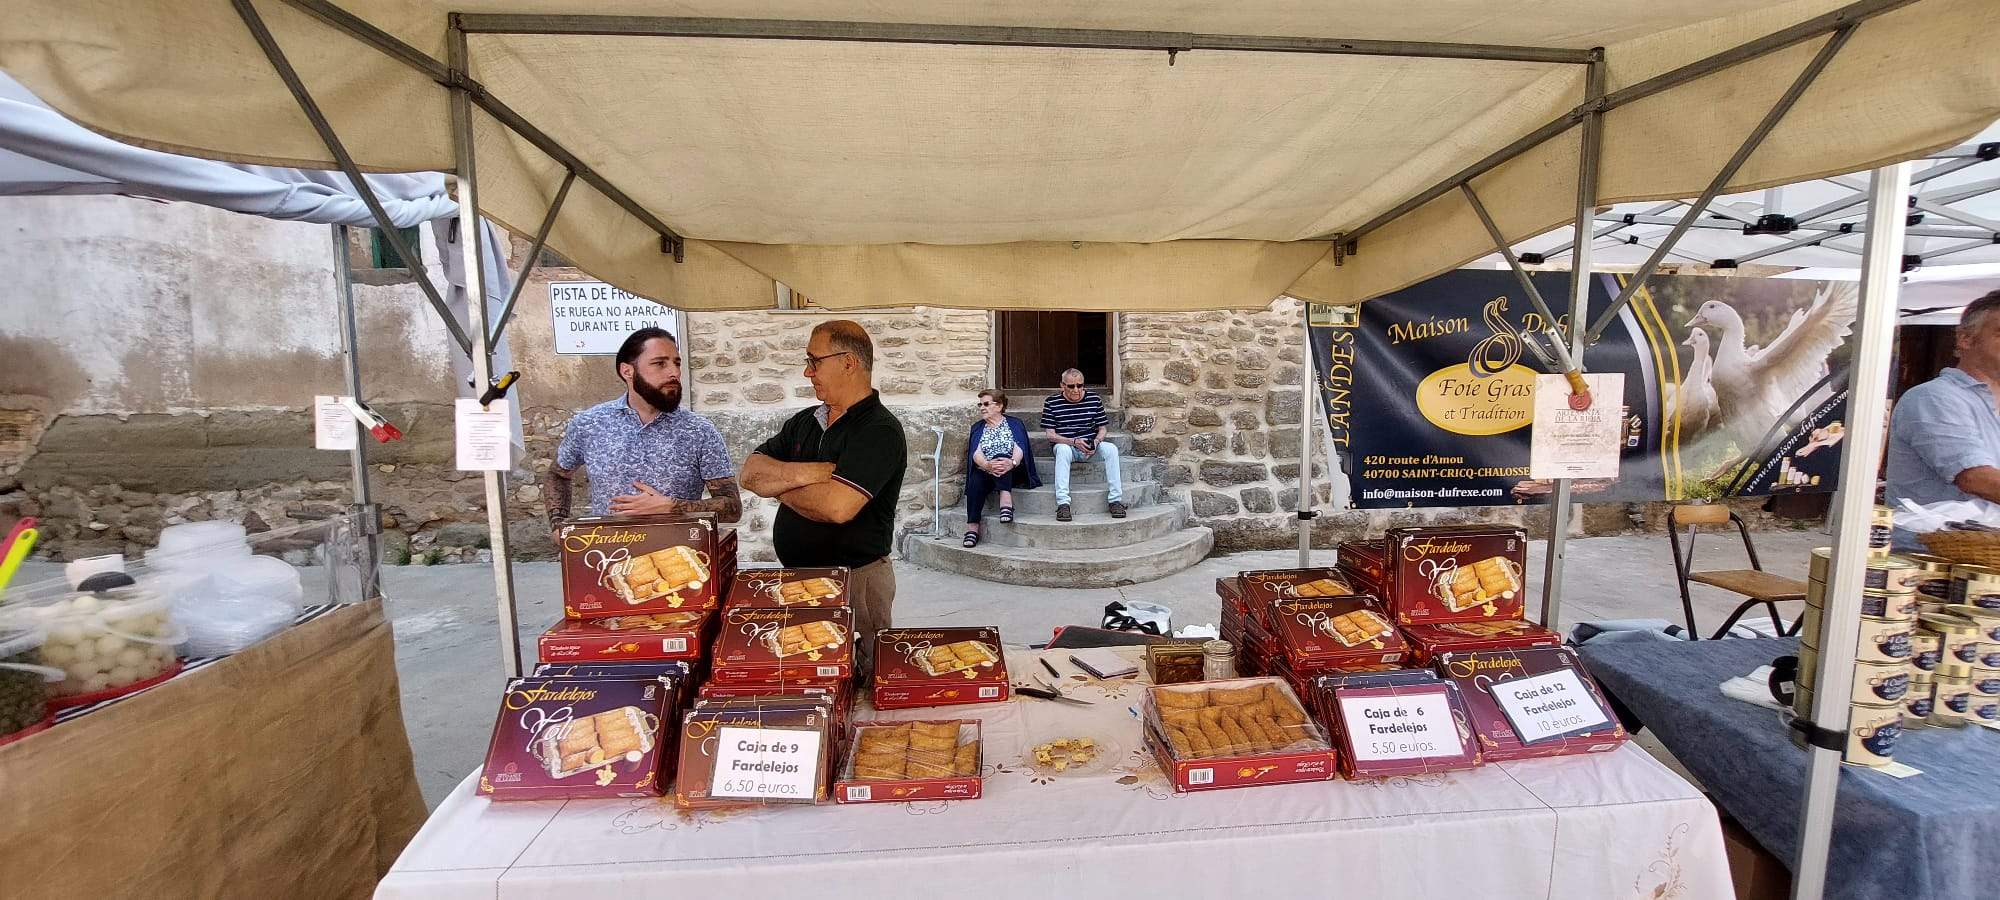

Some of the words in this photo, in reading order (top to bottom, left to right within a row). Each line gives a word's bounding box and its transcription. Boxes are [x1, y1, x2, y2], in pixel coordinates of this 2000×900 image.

[553, 287, 587, 301] PISTA
[591, 287, 607, 301] DE
[555, 306, 566, 318] SE
[569, 306, 602, 318] RUEGA
[606, 306, 621, 317] NO
[625, 305, 674, 317] APARCAR
[570, 321, 619, 331] DURANTE
[625, 320, 637, 331] EL
[1388, 315, 1470, 344] Maison
[1325, 330, 1355, 448] LANDES
[1439, 378, 1481, 397] Foie
[1488, 378, 1532, 402] Gras
[1444, 407, 1456, 420] et
[1459, 403, 1526, 420] Tradition
[1363, 455, 1386, 465] 420
[1388, 456, 1420, 465] route
[1422, 454, 1464, 465] d'Amou
[1363, 469, 1400, 479] 40700
[1401, 466, 1530, 479] SAINT-CRICQ-CHALOSSE
[1362, 487, 1503, 500] info@maison-dufrexe.com
[564, 525, 647, 552] Fardelejos
[1403, 536, 1472, 561] Fardelejos
[1278, 598, 1333, 616] Fardelejos
[879, 629, 944, 644] Fardelejos
[1448, 652, 1522, 678] Fardelejos
[506, 680, 597, 710] Fardelejos
[1514, 690, 1539, 701] Caja
[1541, 684, 1553, 696] de
[1554, 682, 1567, 692] 12
[1364, 708, 1391, 720] Caja
[1393, 707, 1408, 717] de
[1416, 706, 1425, 716] 6
[1523, 698, 1576, 717] Fardelejos
[1369, 722, 1428, 735] Fardelejos
[1537, 719, 1551, 733] 10
[1552, 714, 1586, 729] euros.
[737, 740, 767, 754] Caja
[771, 741, 787, 753] de
[790, 743, 799, 753] 9
[1371, 742, 1396, 755] 5,50
[1399, 741, 1437, 753] euros.
[731, 759, 799, 774] Fardelejos
[724, 779, 754, 793] 6,50
[757, 782, 799, 795] euros.
